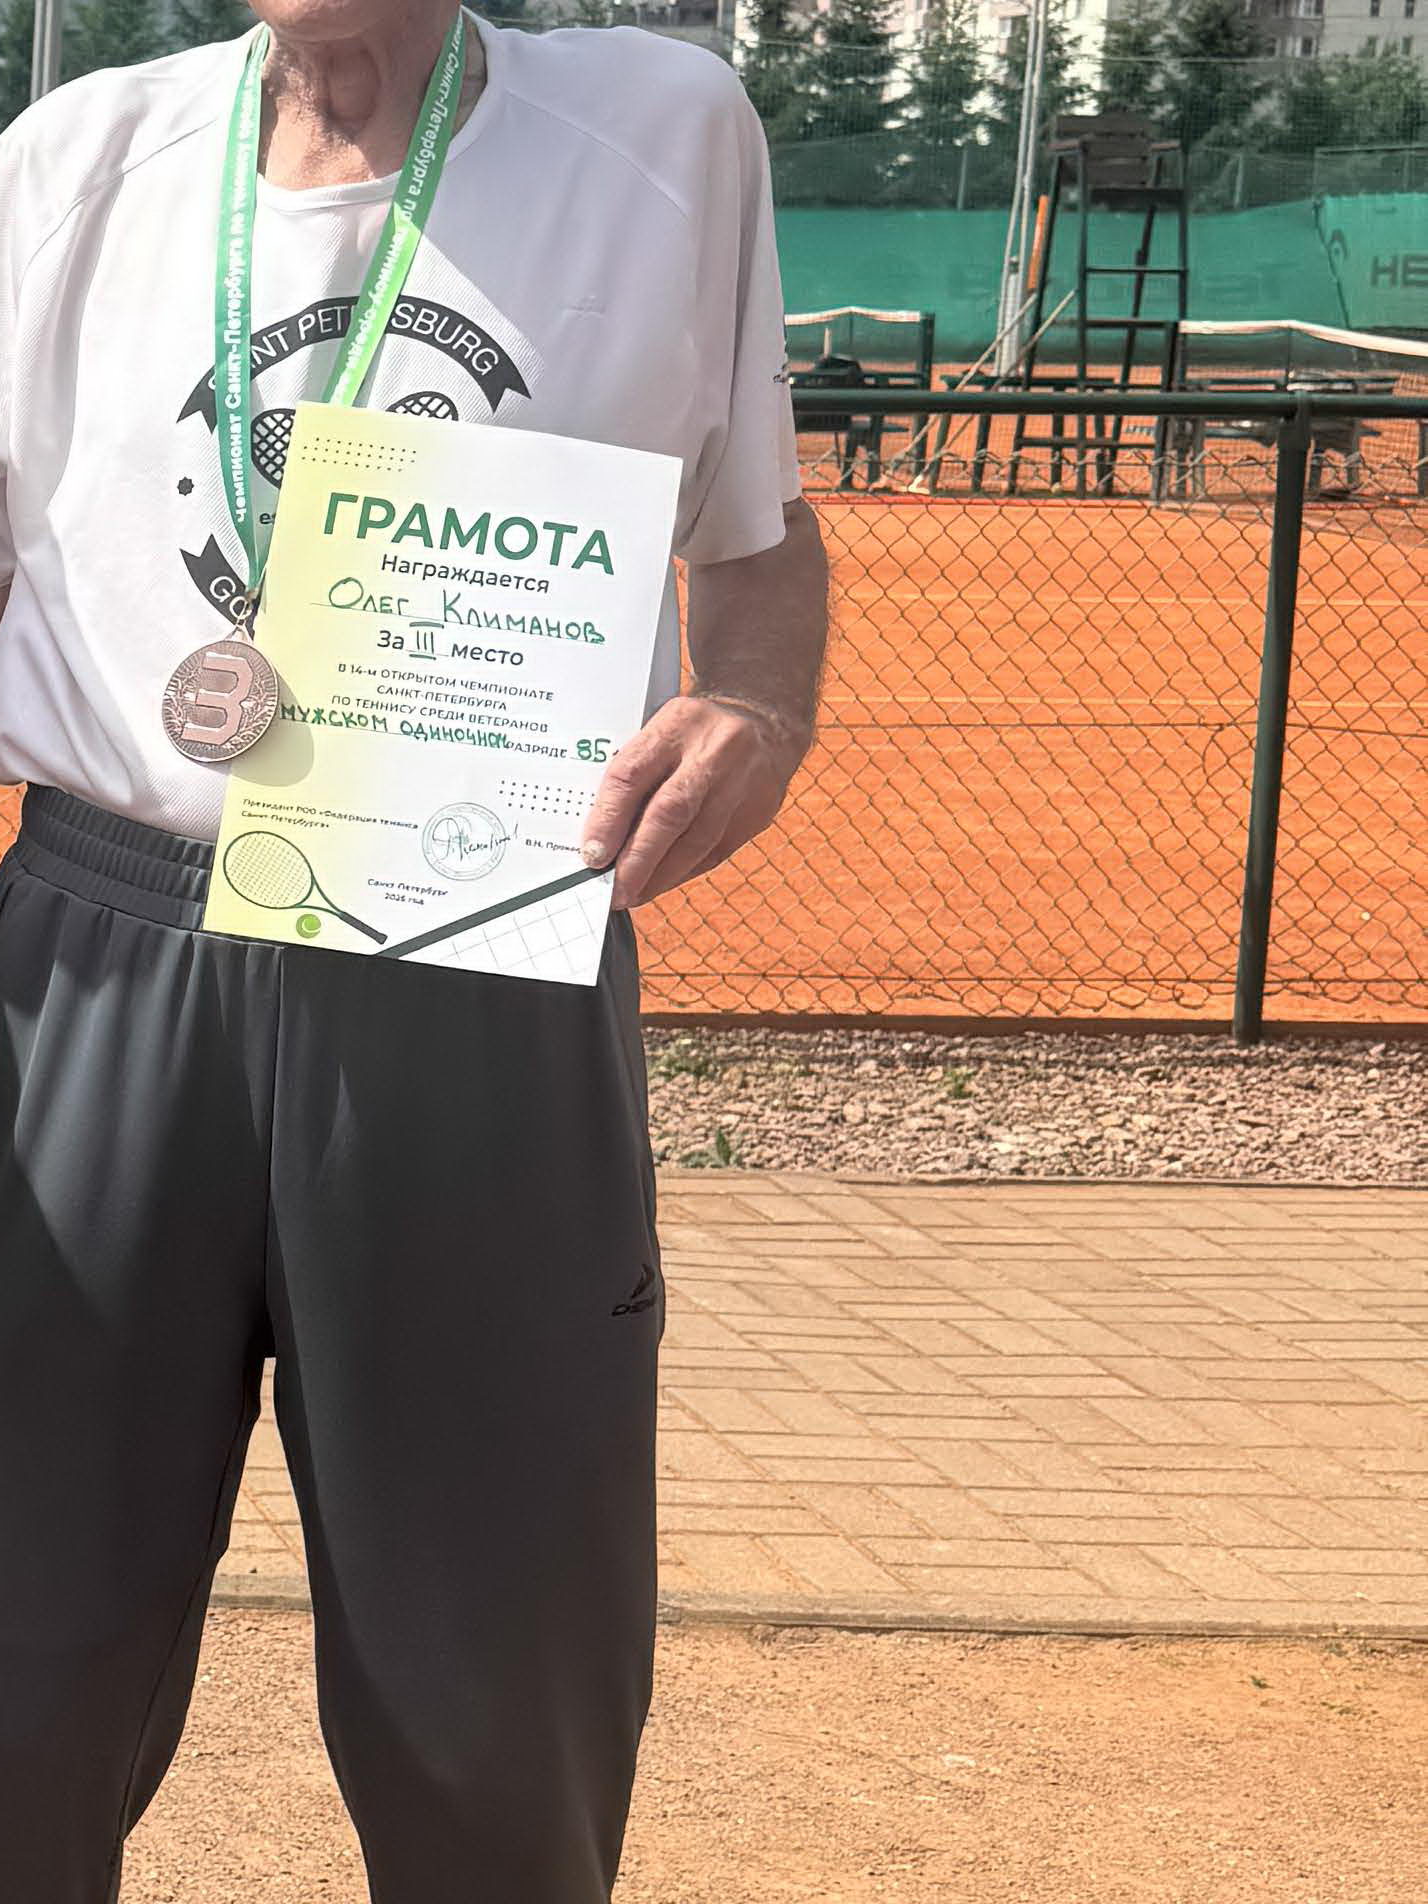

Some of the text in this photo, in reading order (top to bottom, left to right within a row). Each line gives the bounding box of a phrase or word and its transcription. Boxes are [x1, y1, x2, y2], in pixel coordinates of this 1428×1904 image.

[297, 302, 498, 377] PETSBURG
[324, 492, 615, 576] ГРАМОТА
[381, 554, 551, 595] Награждается
[377, 630, 405, 651] За
[451, 642, 525, 667] место
[180, 651, 254, 746] 3
[376, 684, 508, 711] САНКТ-ПЕТЕРБУРГА
[380, 668, 458, 688] ОТКРЫТОМ
[460, 679, 555, 702] ЧЕМПИОНАТЕ
[279, 703, 388, 734] МУЖСКОМ
[576, 737, 619, 764] 85
[331, 695, 549, 733] ПО ТЕННИСУ СРЕДИ ВЕТЕРАНОВ
